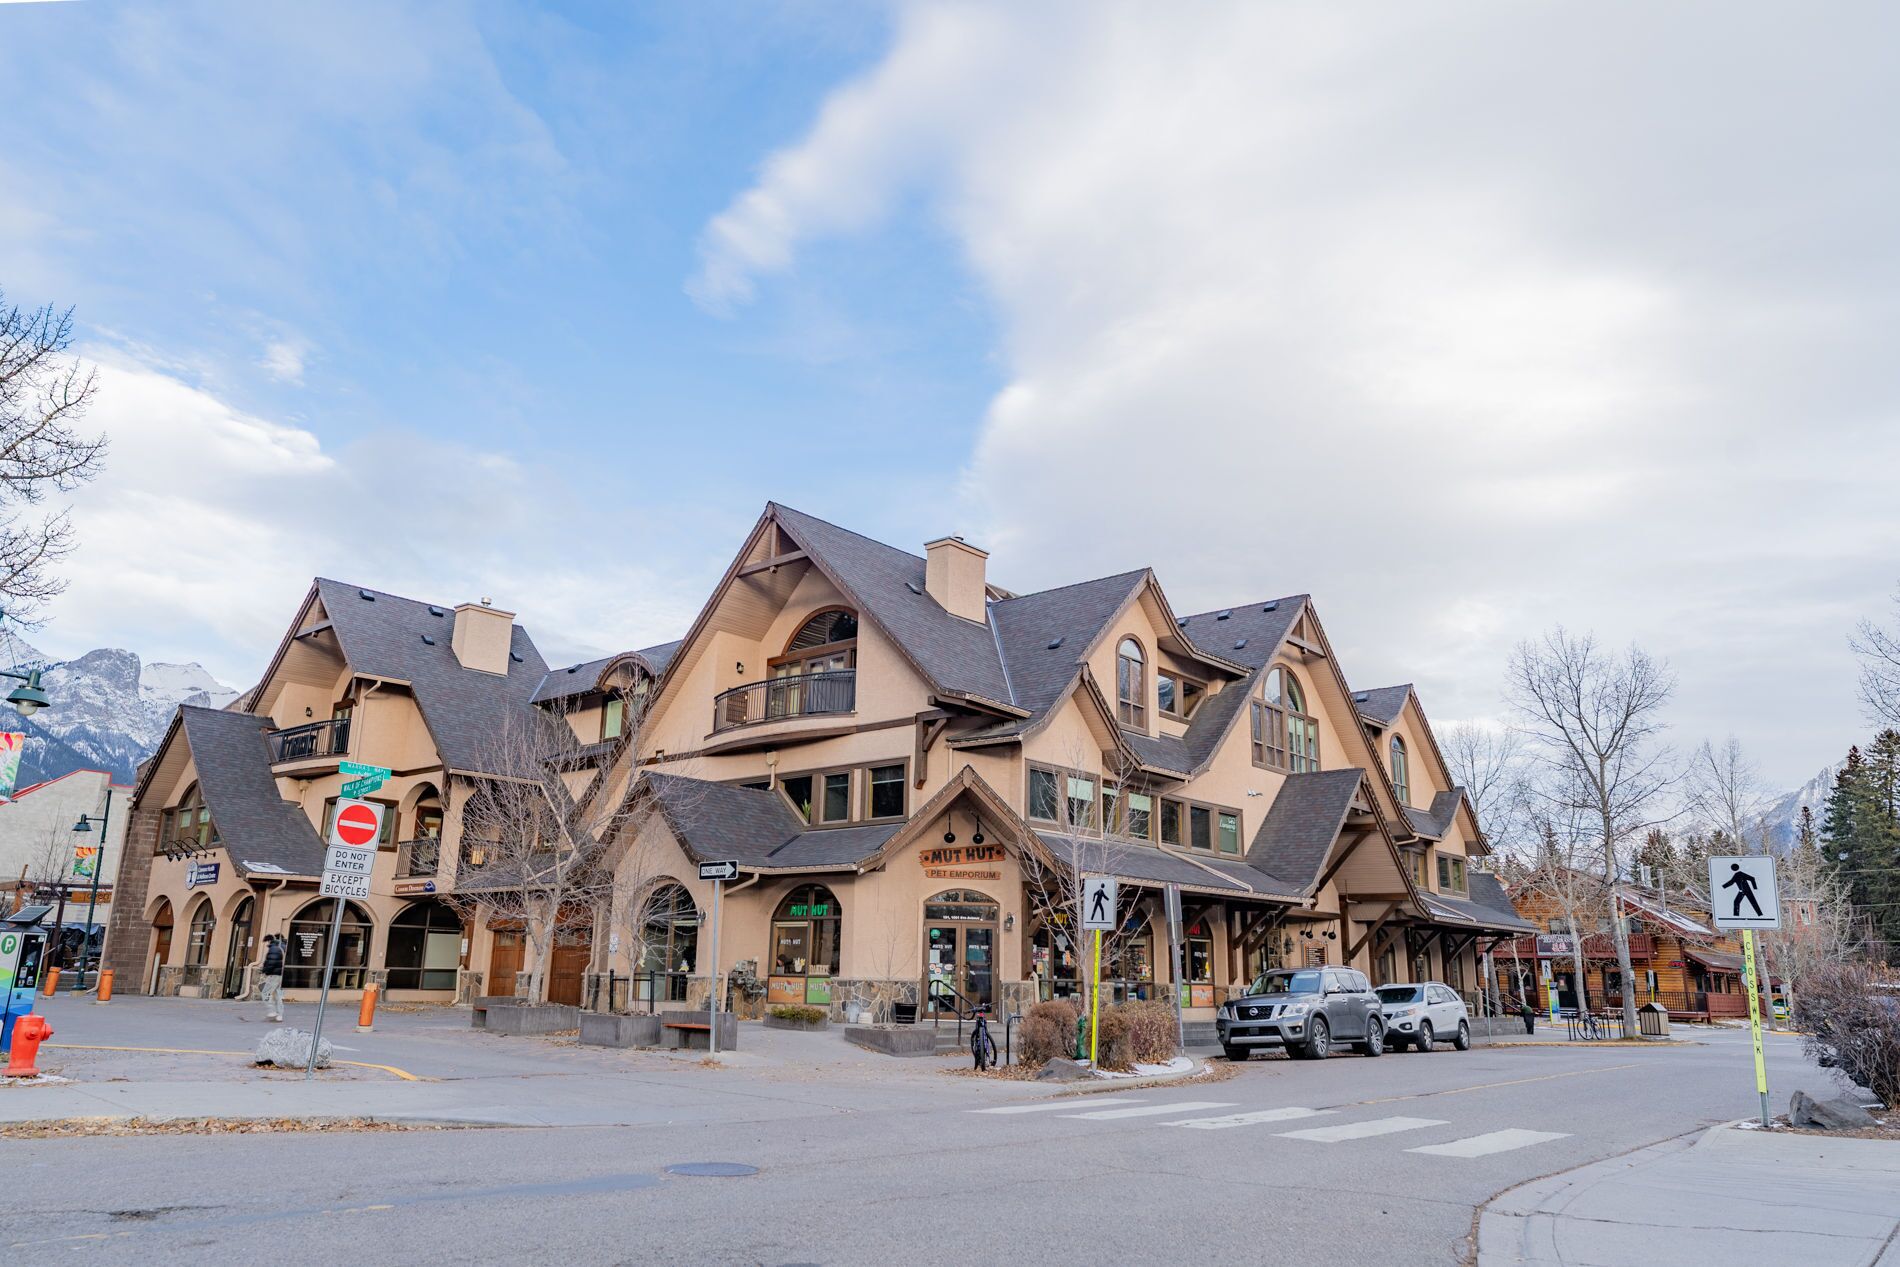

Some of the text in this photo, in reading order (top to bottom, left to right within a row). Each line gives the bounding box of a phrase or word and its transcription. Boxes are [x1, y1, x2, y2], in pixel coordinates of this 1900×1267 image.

[335, 850, 368, 861] DO NOT
[930, 846, 995, 864] MUT HUT
[334, 860, 365, 871] ENTER
[701, 866, 727, 875] ONE WAY
[330, 874, 364, 886] EXCEPT
[930, 869, 997, 879] PET EMPORIUM
[324, 884, 367, 897] BICYCLES
[790, 903, 828, 916] MUT HUT
[1745, 941, 1762, 1055] CROSSWALK
